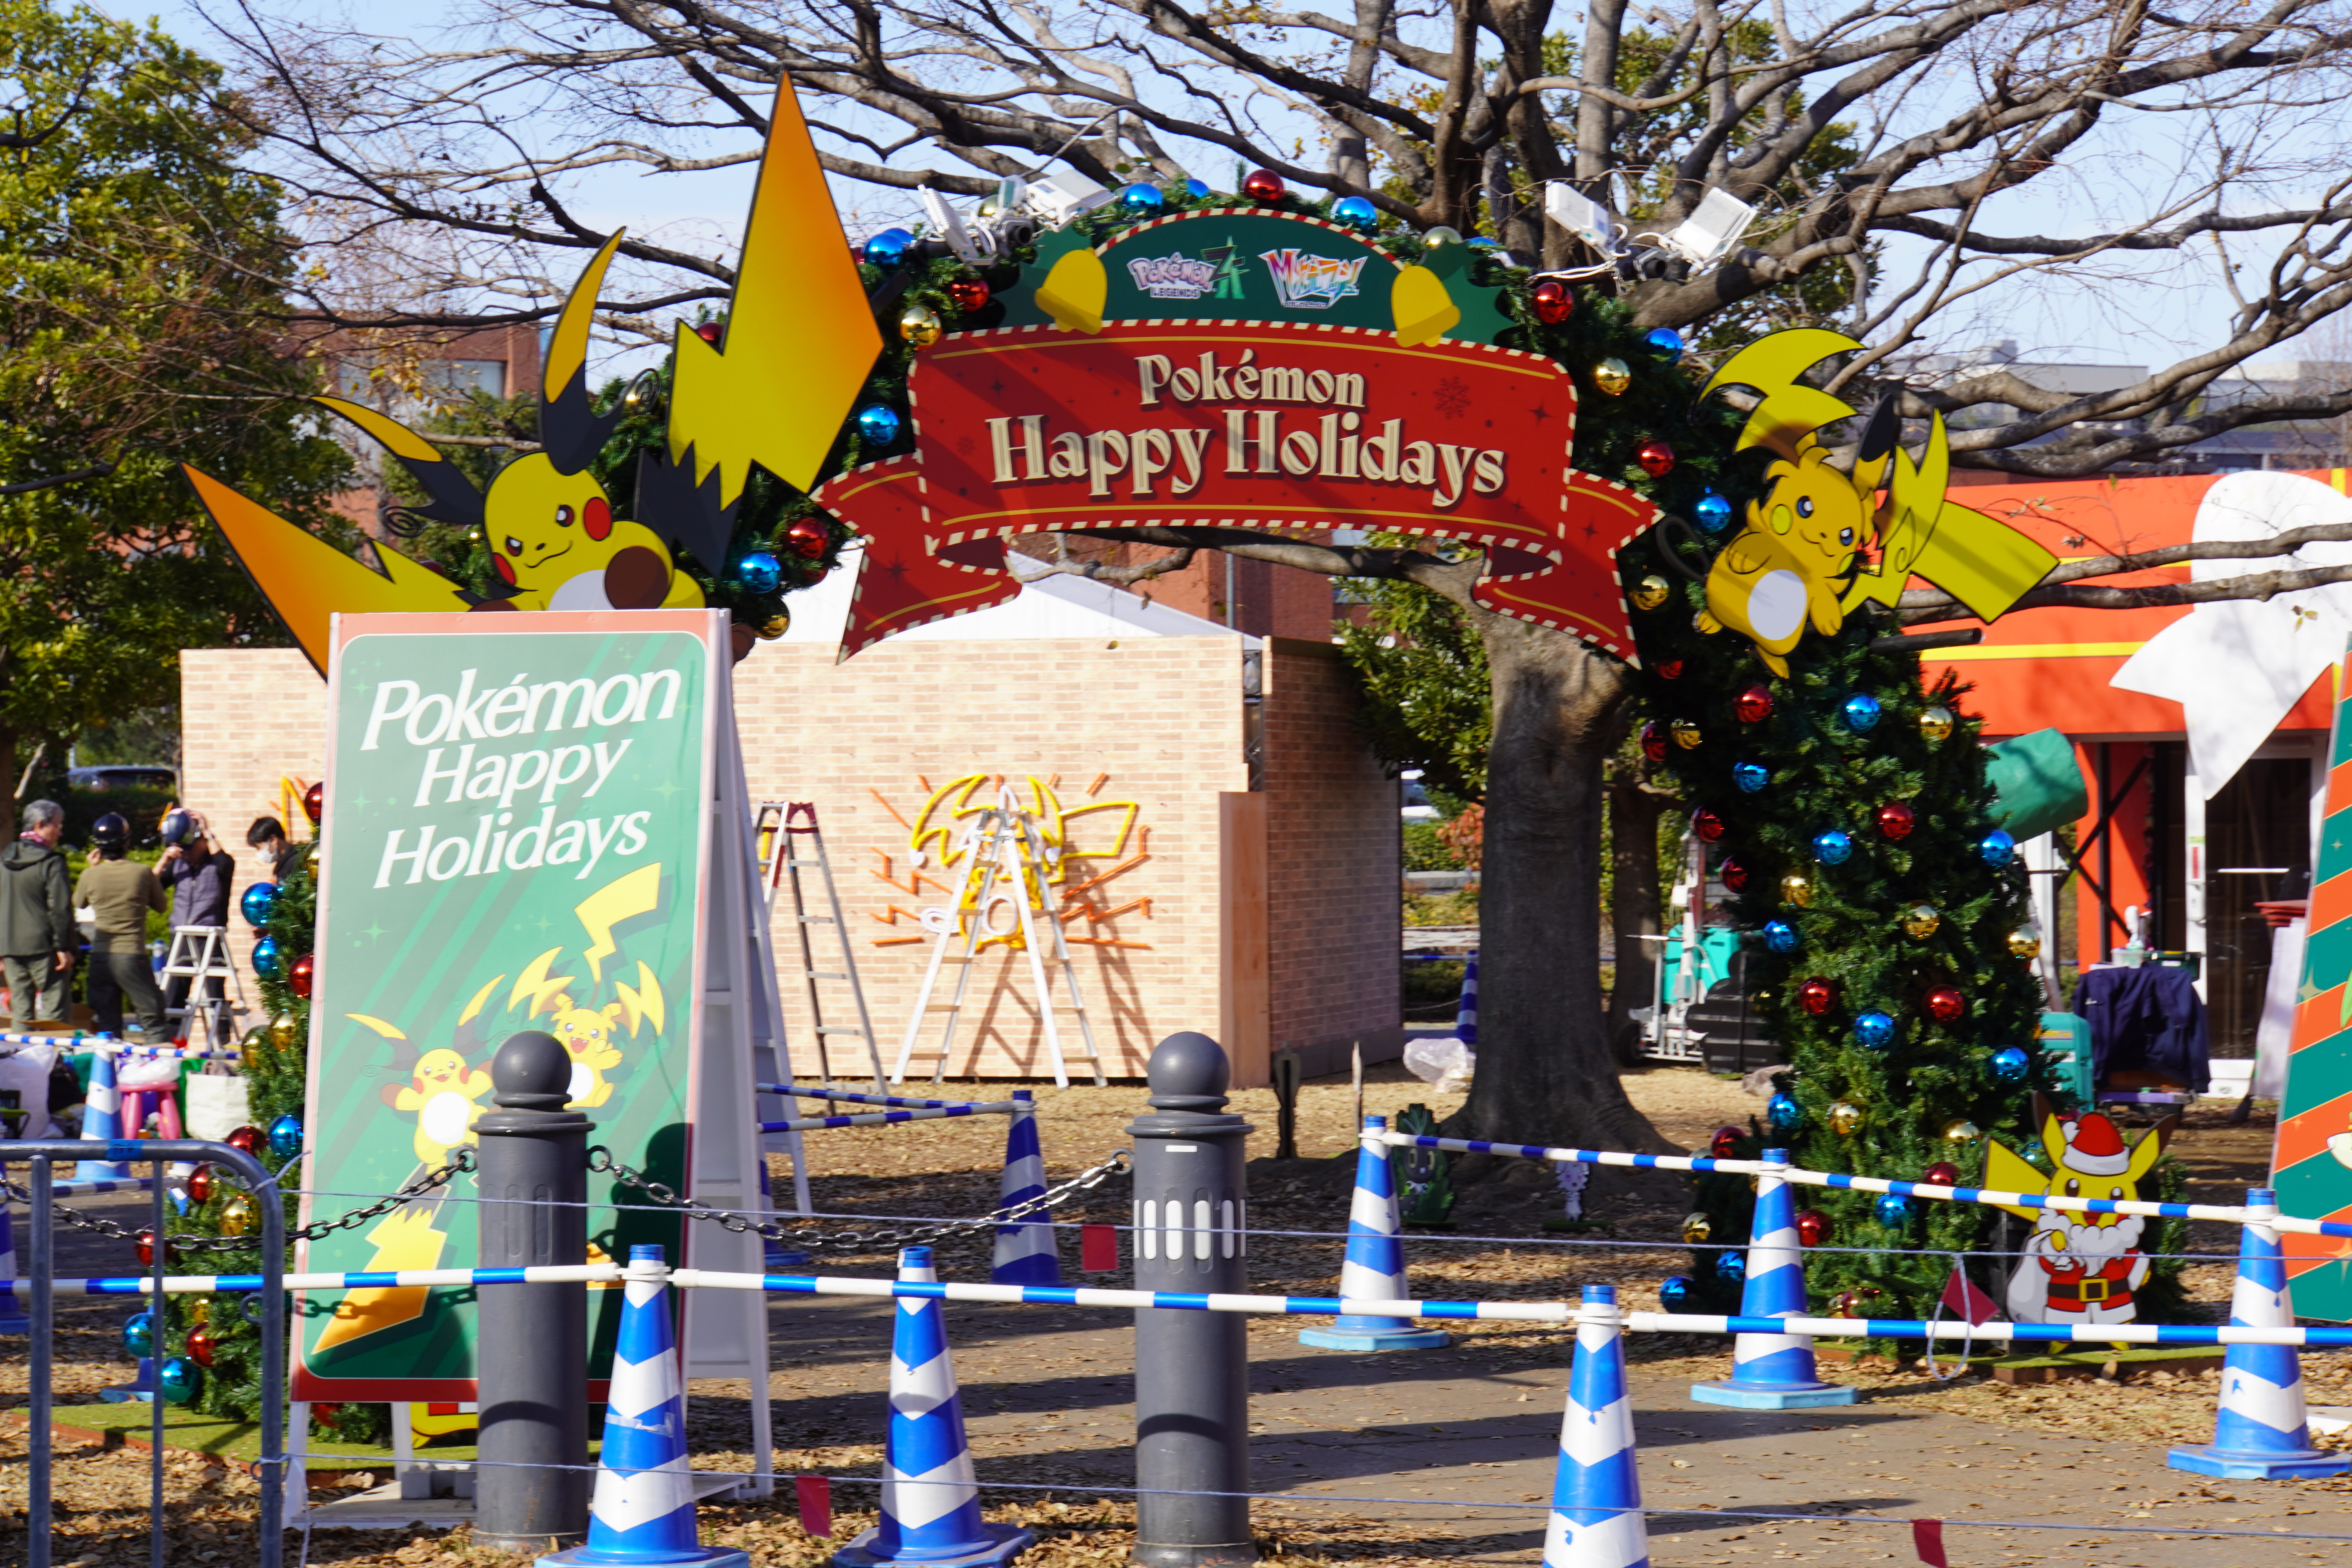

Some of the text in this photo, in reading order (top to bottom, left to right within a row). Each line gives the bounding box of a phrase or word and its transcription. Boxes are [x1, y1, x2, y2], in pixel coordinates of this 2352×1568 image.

[1151, 287, 1200, 298] LEGENDS
[1134, 348, 1365, 407] Pokémon
[985, 410, 1504, 506] Happy Holidays
[359, 668, 681, 750] Pokémon
[413, 739, 634, 809] Happy
[373, 805, 652, 888] Holidays
